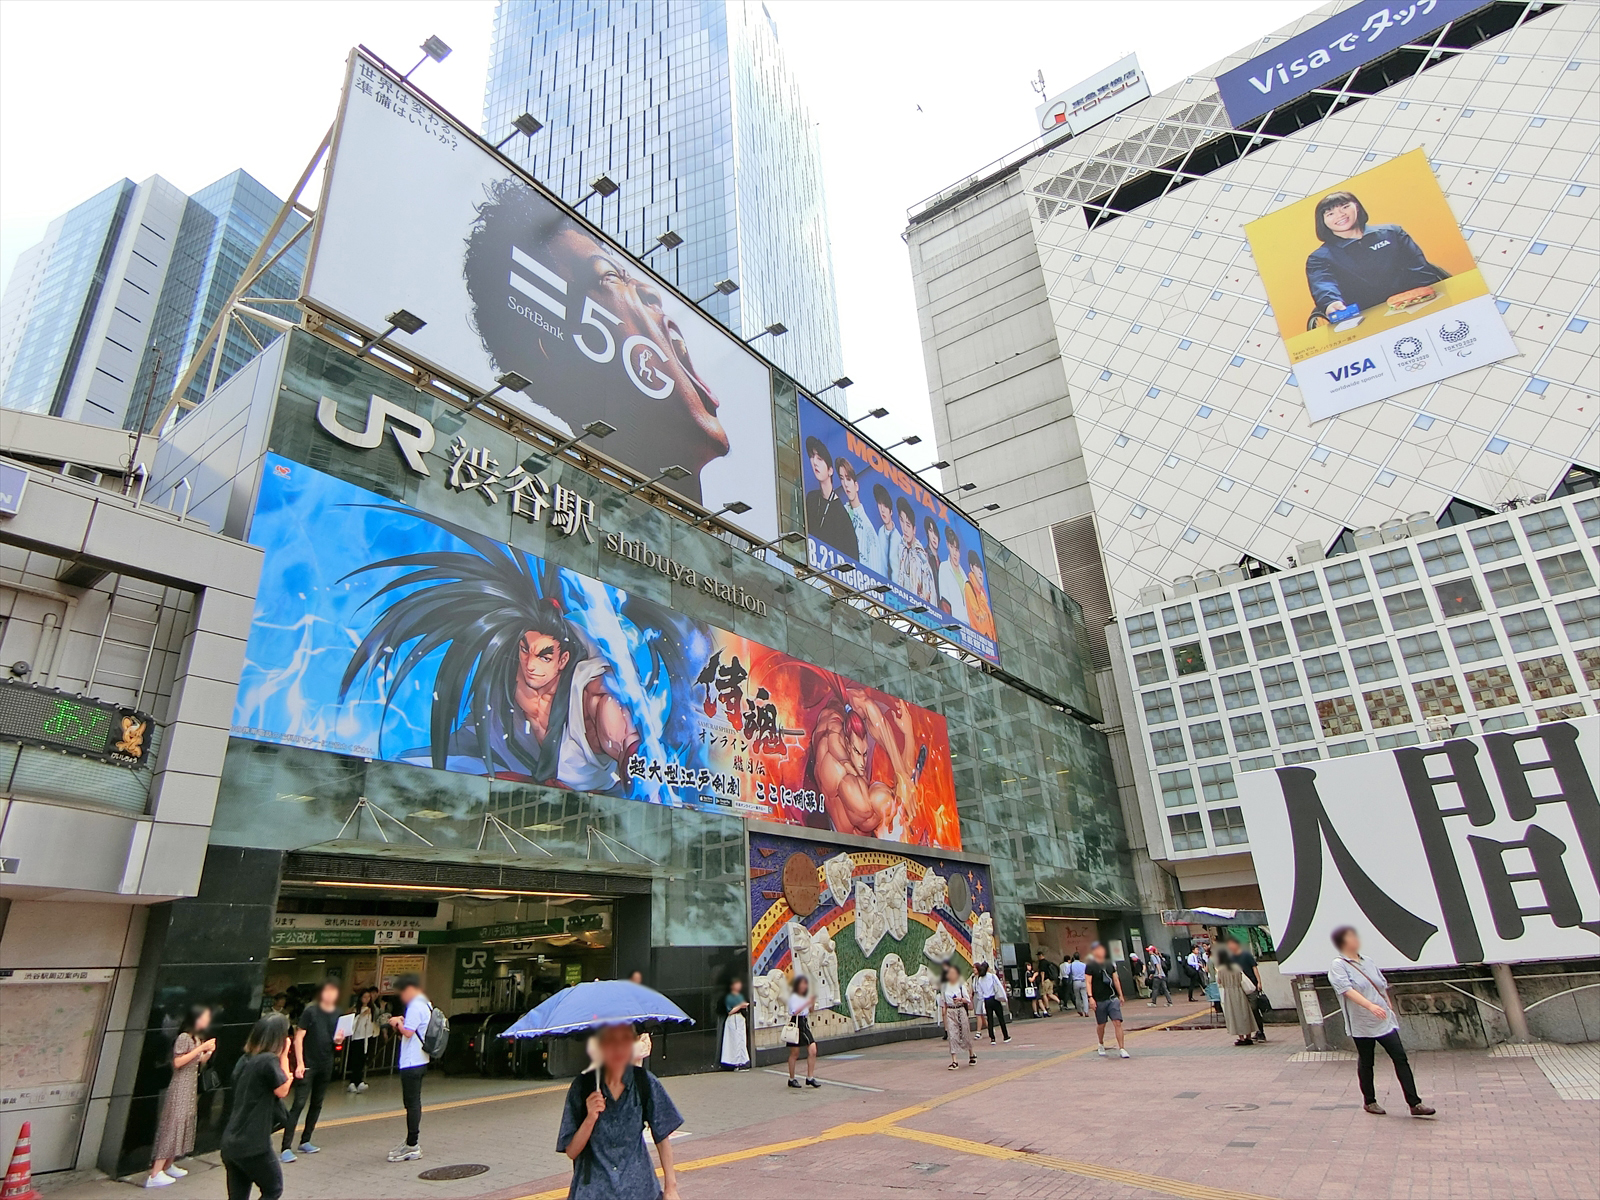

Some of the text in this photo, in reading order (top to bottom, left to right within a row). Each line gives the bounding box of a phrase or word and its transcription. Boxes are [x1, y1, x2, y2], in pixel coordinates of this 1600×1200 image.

[355, 77, 458, 151] 準備はいいか?
[359, 64, 457, 140] 世界は変わる。
[1068, 76, 1140, 116] TOKYU
[1369, 240, 1391, 251] VISA
[507, 296, 564, 341] SoftBank
[572, 296, 675, 399] 5G
[1397, 353, 1430, 368] TOKYO 2020
[1444, 342, 1463, 351] TOKYO
[1463, 337, 1477, 346] 2020
[1324, 357, 1376, 382] VISA
[1329, 372, 1384, 394] worldwide sponsor
[316, 394, 436, 477] JR
[450, 435, 596, 545] 渋谷駅
[845, 430, 950, 525] MONSTA X
[606, 532, 767, 617] shibuya station
[698, 728, 749, 753] オンライン
[628, 755, 741, 797] 超大型江戸剣劇
[1275, 721, 1600, 966] 人間
[324, 918, 421, 928] 改札内には階段しかありません
[24, 972, 88, 980] 渋谷駅周辺案内図
[462, 951, 487, 968] JR
